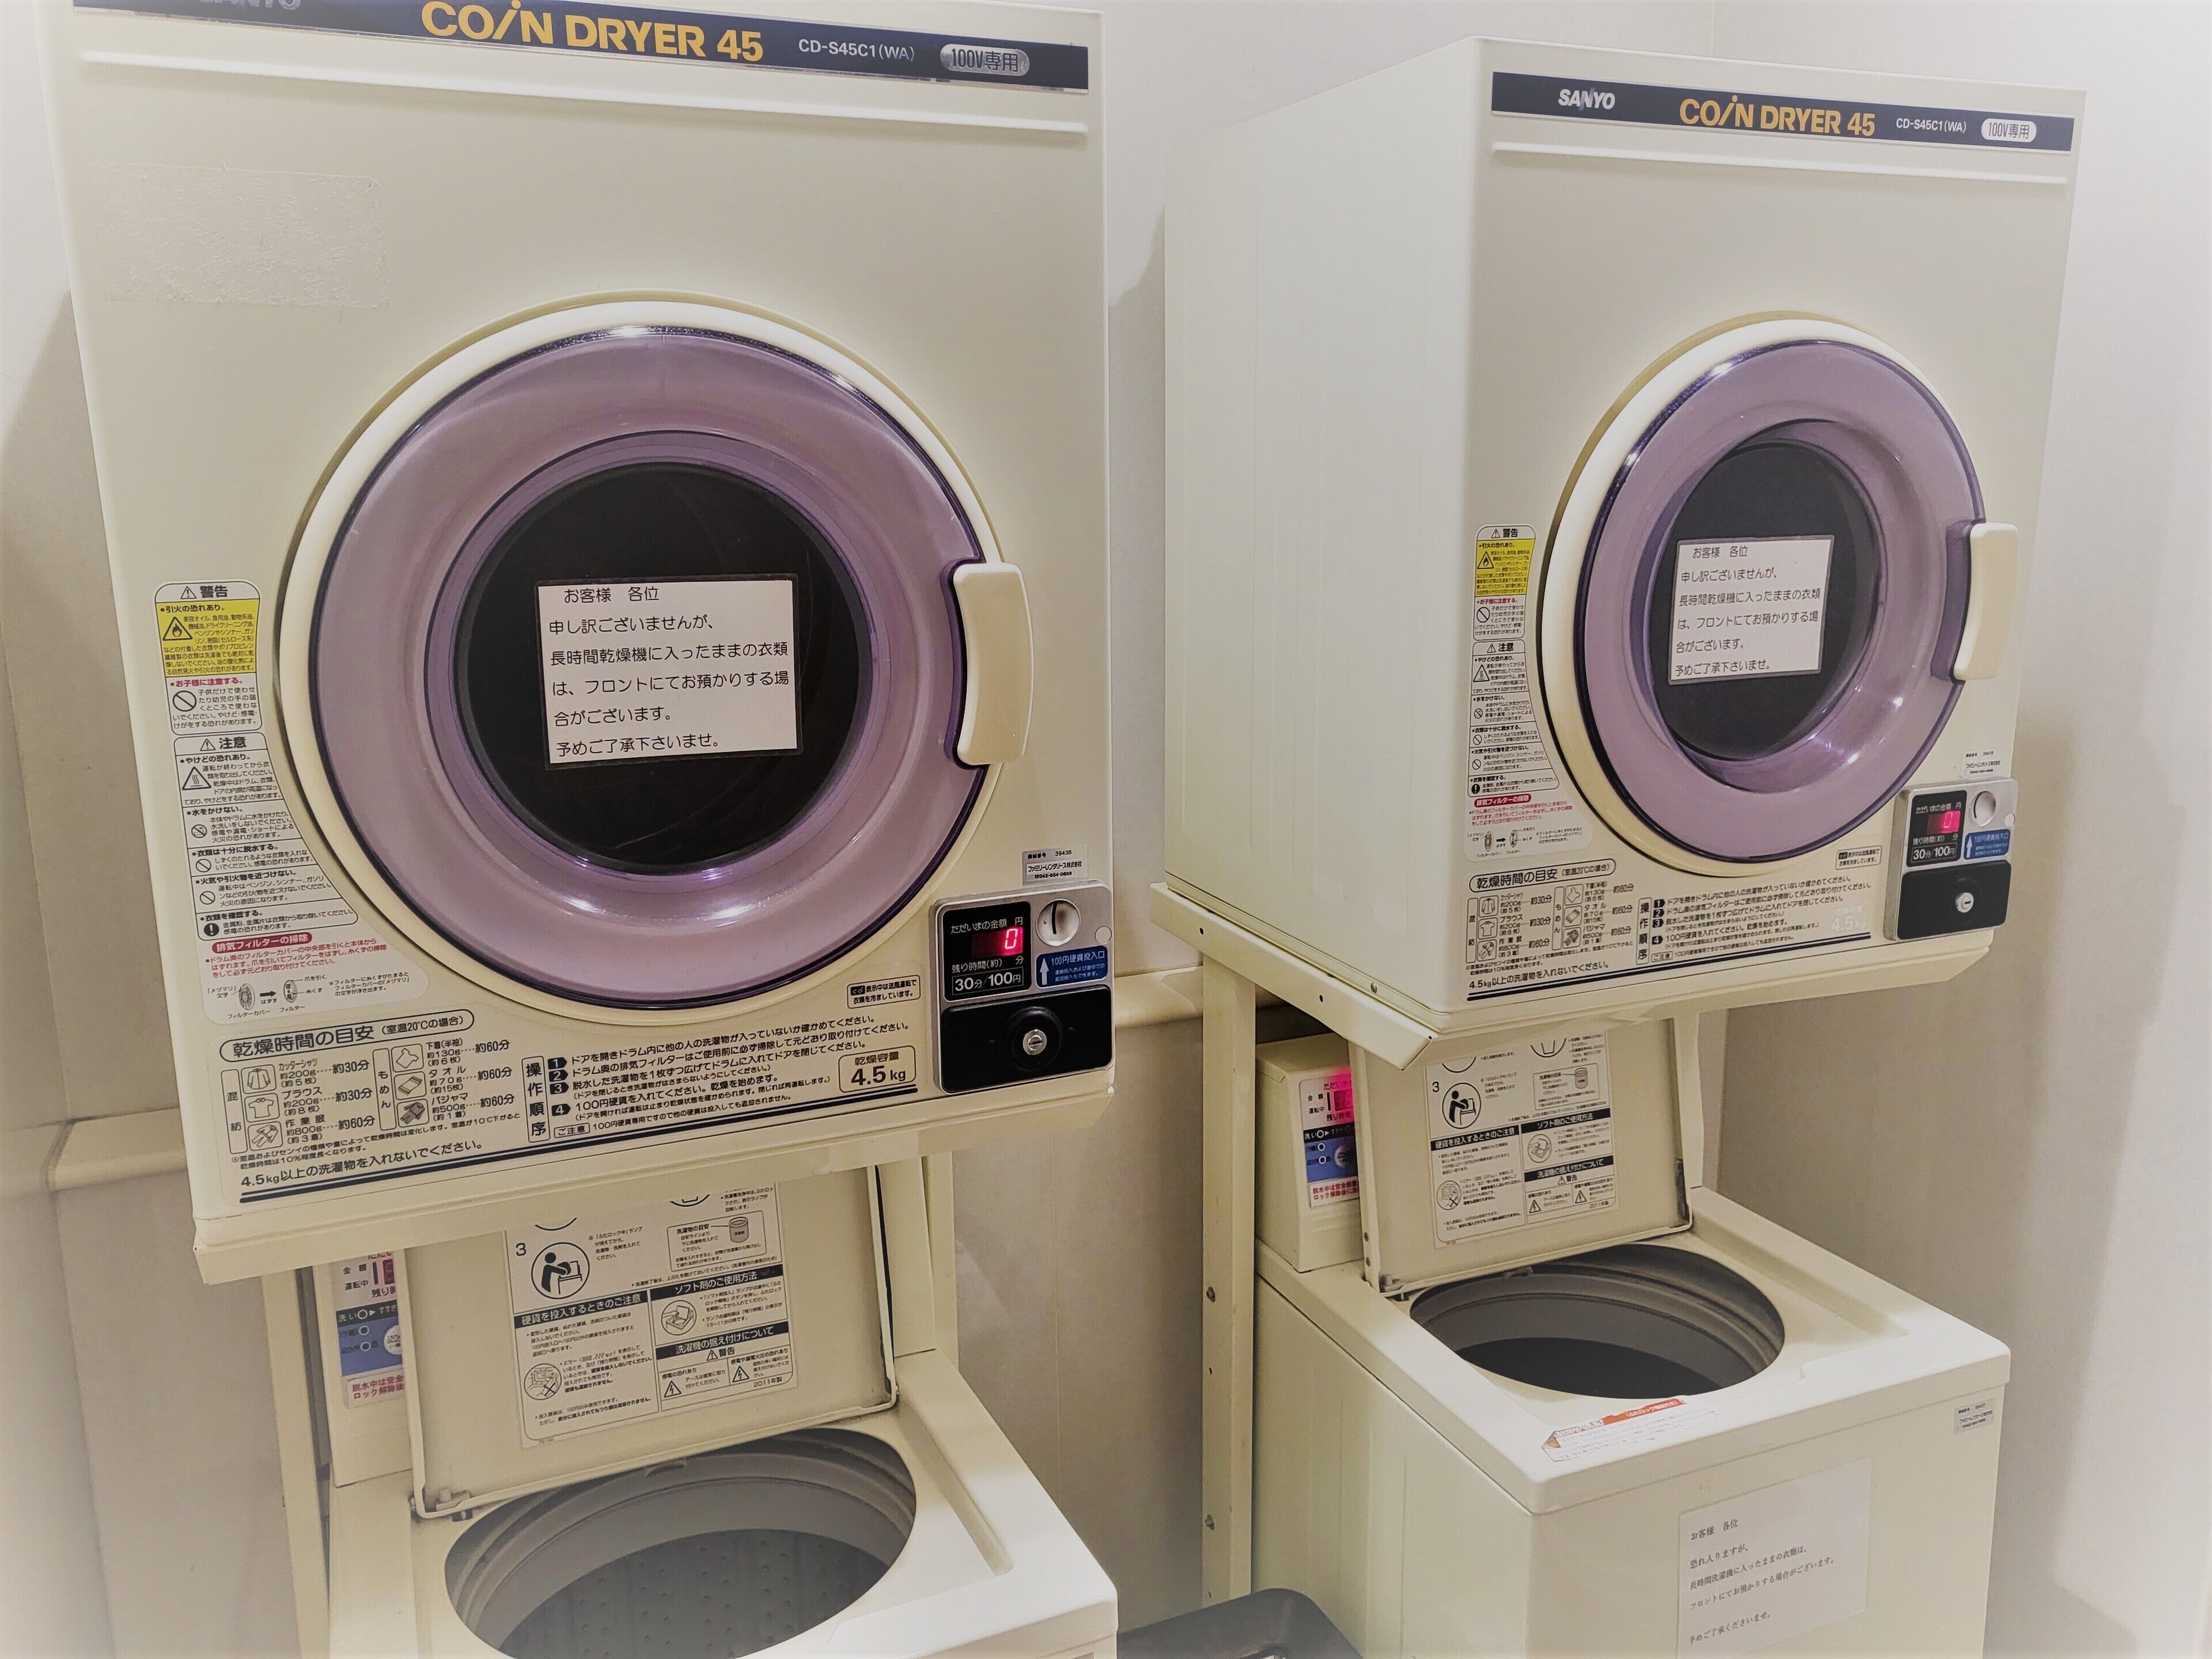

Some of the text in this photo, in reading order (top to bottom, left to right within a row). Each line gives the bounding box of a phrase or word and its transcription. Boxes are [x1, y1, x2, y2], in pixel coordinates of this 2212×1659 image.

[565, 15, 705, 58] DRYER
[717, 29, 763, 62] 45
[798, 38, 915, 62] CD-S45C1(WA)
[951, 47, 1018, 73] 100V専用
[1558, 88, 1615, 111] SANYO
[1760, 105, 1840, 135] DRYER
[1847, 111, 1875, 136] 45
[1896, 117, 1967, 135] CD-S45C1(WA)
[1987, 121, 2030, 140] 100V専用
[1503, 529, 1518, 537] 警告
[1692, 546, 1748, 559] お客様 各位
[1681, 567, 1777, 583] 申し訳ございませんが、
[200, 586, 228, 598] 警告
[564, 586, 659, 603] お客様 各位
[1679, 588, 1821, 607] 長時間乾燥機に入ったままの衣類
[165, 604, 225, 613] 引火の恐れあり。
[549, 614, 713, 635] 申し訳ございませんが、
[1677, 611, 1818, 630] は、フロントにてお預かりする場
[550, 642, 788, 666] 長時間乾燥機に入ったままの衣類
[1498, 643, 1513, 652] 注意
[1676, 638, 1744, 654] 合がございます。
[1675, 660, 1770, 676] 予めご了承下さいませ。
[176, 677, 243, 687] お子様に注意する。
[552, 670, 789, 696] は、フロントにてお預かりする場
[198, 687, 255, 696] 子供だけで使わせ
[200, 703, 257, 711] くところで使わな
[554, 706, 671, 727] 合がございます。
[219, 737, 247, 749] 注意
[556, 733, 719, 757] 予めご了承下さいませ。
[185, 754, 250, 764] やけどの恐れあり。
[192, 806, 243, 816] 水をかけない。
[1944, 812, 1953, 828] 0
[197, 844, 278, 857] 衣類は十分に脱水する。
[201, 870, 296, 885] 火気や引火物を近づけない。
[1476, 869, 1558, 889] 乾燥時間の目安
[205, 910, 263, 921] 衣類を確認する。
[1500, 914, 1523, 923] ブラウス
[951, 916, 1023, 934] ただいまの金額 円
[217, 934, 308, 952] 排気フィルターの掃除
[1005, 928, 1018, 949] 0
[952, 956, 1024, 974] 残り時間(約) 分
[1051, 951, 1104, 965] 100円硬貨投入口
[233, 1025, 374, 1058] 乾燥時間の目安
[475, 1039, 510, 1054] 約60分
[571, 1015, 875, 1065] ドアを開きドラム内に他の人の洗濯物が入っていないか確かめてください。
[332, 1059, 370, 1074] 約30分
[854, 1051, 899, 1066] 乾燥容量
[478, 1067, 512, 1081] 約60分
[851, 1066, 906, 1086] 4.5 kg
[282, 1086, 322, 1099] ブラウス
[335, 1088, 373, 1102] 約30分
[1432, 1081, 1440, 1093] 3
[431, 1092, 468, 1105] パジャマ
[480, 1094, 515, 1108] 約60分
[527, 1063, 546, 1137] 操作順序
[338, 1116, 375, 1130] 約60分
[241, 1141, 483, 1188] 4.5kg以上の洗濯物を入れないでください。
[516, 1243, 527, 1256] 3
[675, 1272, 757, 1294] ソフト剤のご使用方法
[522, 1294, 641, 1325] 硬貨を投入するときのご注意
[676, 1327, 774, 1354] 洗濯機の据え付けについて
[1690, 1518, 1738, 1540] お客様 各位
[1690, 1543, 1748, 1569] 恐れ入りますが、
